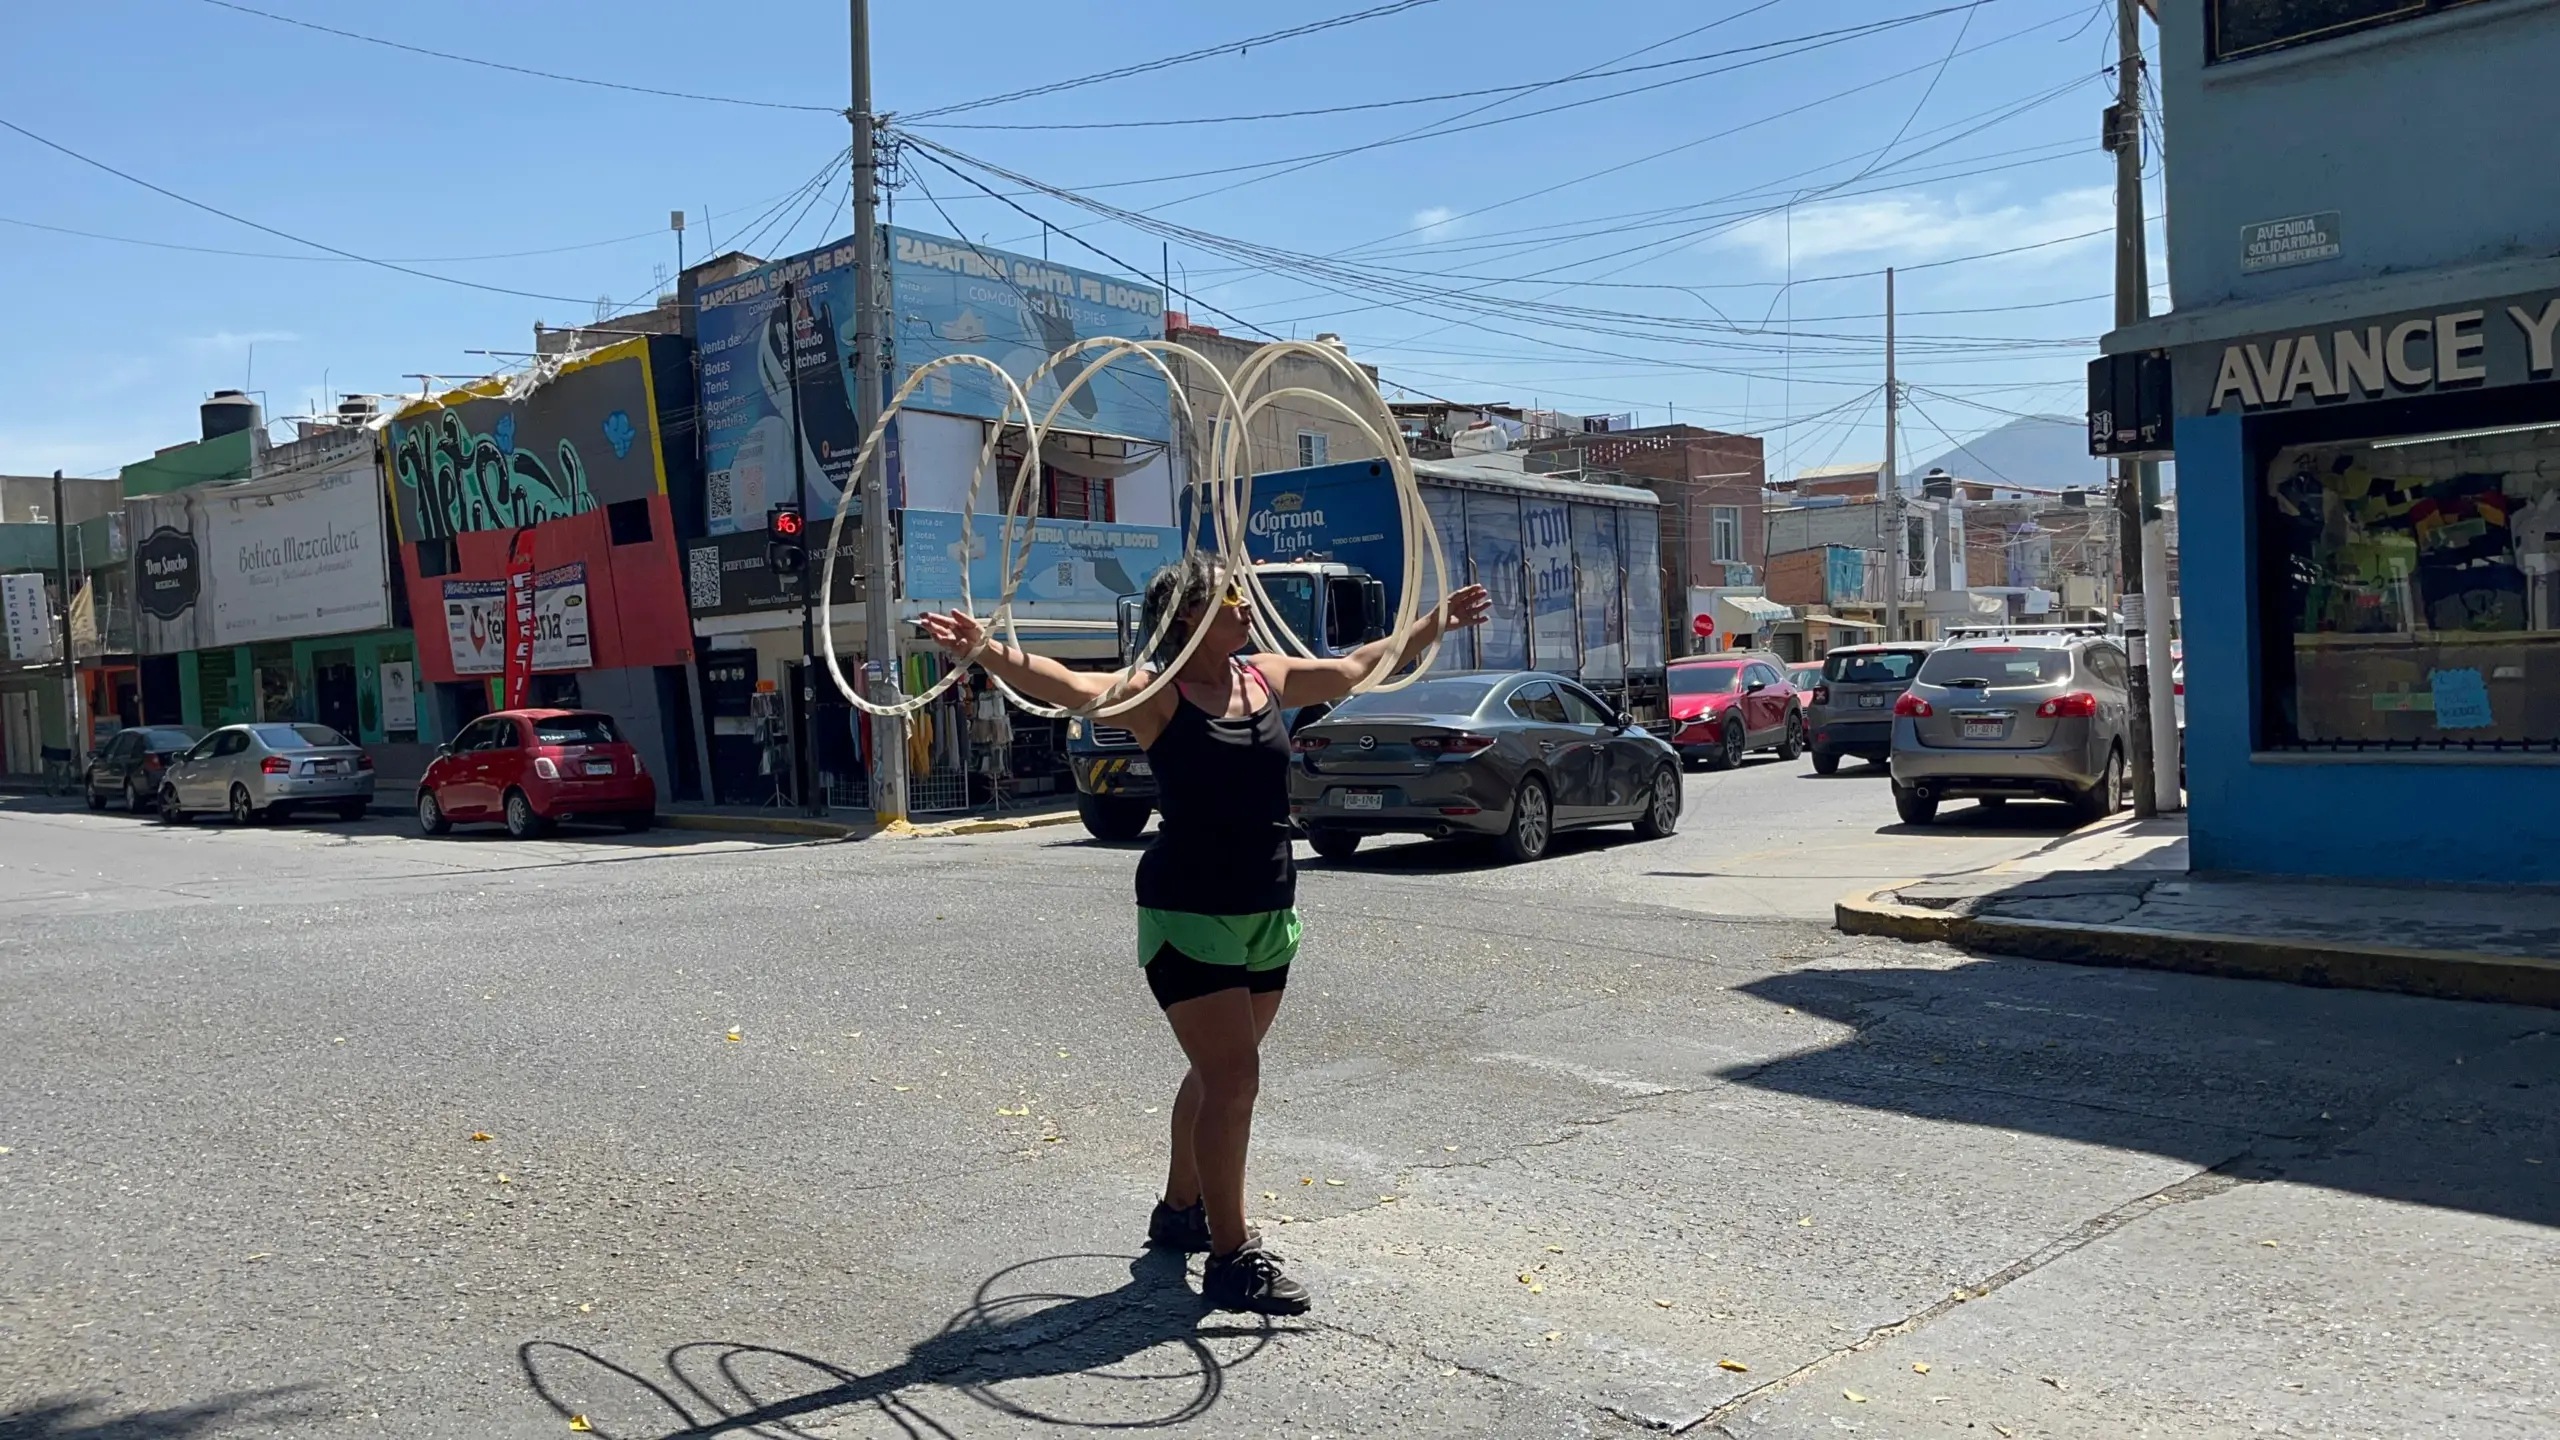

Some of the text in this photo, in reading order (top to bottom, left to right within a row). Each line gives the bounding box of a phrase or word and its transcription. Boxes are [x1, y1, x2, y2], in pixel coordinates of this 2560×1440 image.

[2256, 219, 2316, 241] AVENIDA
[2248, 231, 2327, 256] SOLIDARIDAD
[700, 274, 767, 312] ZAPATERIA
[768, 260, 812, 291] SANTA
[814, 252, 832, 274] FE
[812, 281, 829, 295] PIES
[896, 236, 1162, 318] ZAPATERIA SANTA FE BOOTS
[1082, 310, 1107, 327] PIES
[701, 339, 727, 356] Venta
[704, 361, 731, 376] Botas
[2209, 308, 2488, 413] AVANCE
[705, 379, 729, 394] Tenis
[706, 395, 746, 415] Agujetas
[707, 413, 748, 432] Plantillas
[1250, 508, 1326, 538] Corona
[238, 520, 360, 574] Botica Mezcalera
[1273, 531, 1313, 554] Light
[1332, 537, 1348, 545] TODO
[1349, 536, 1364, 544] CON
[146, 553, 188, 575] Don Sancho
